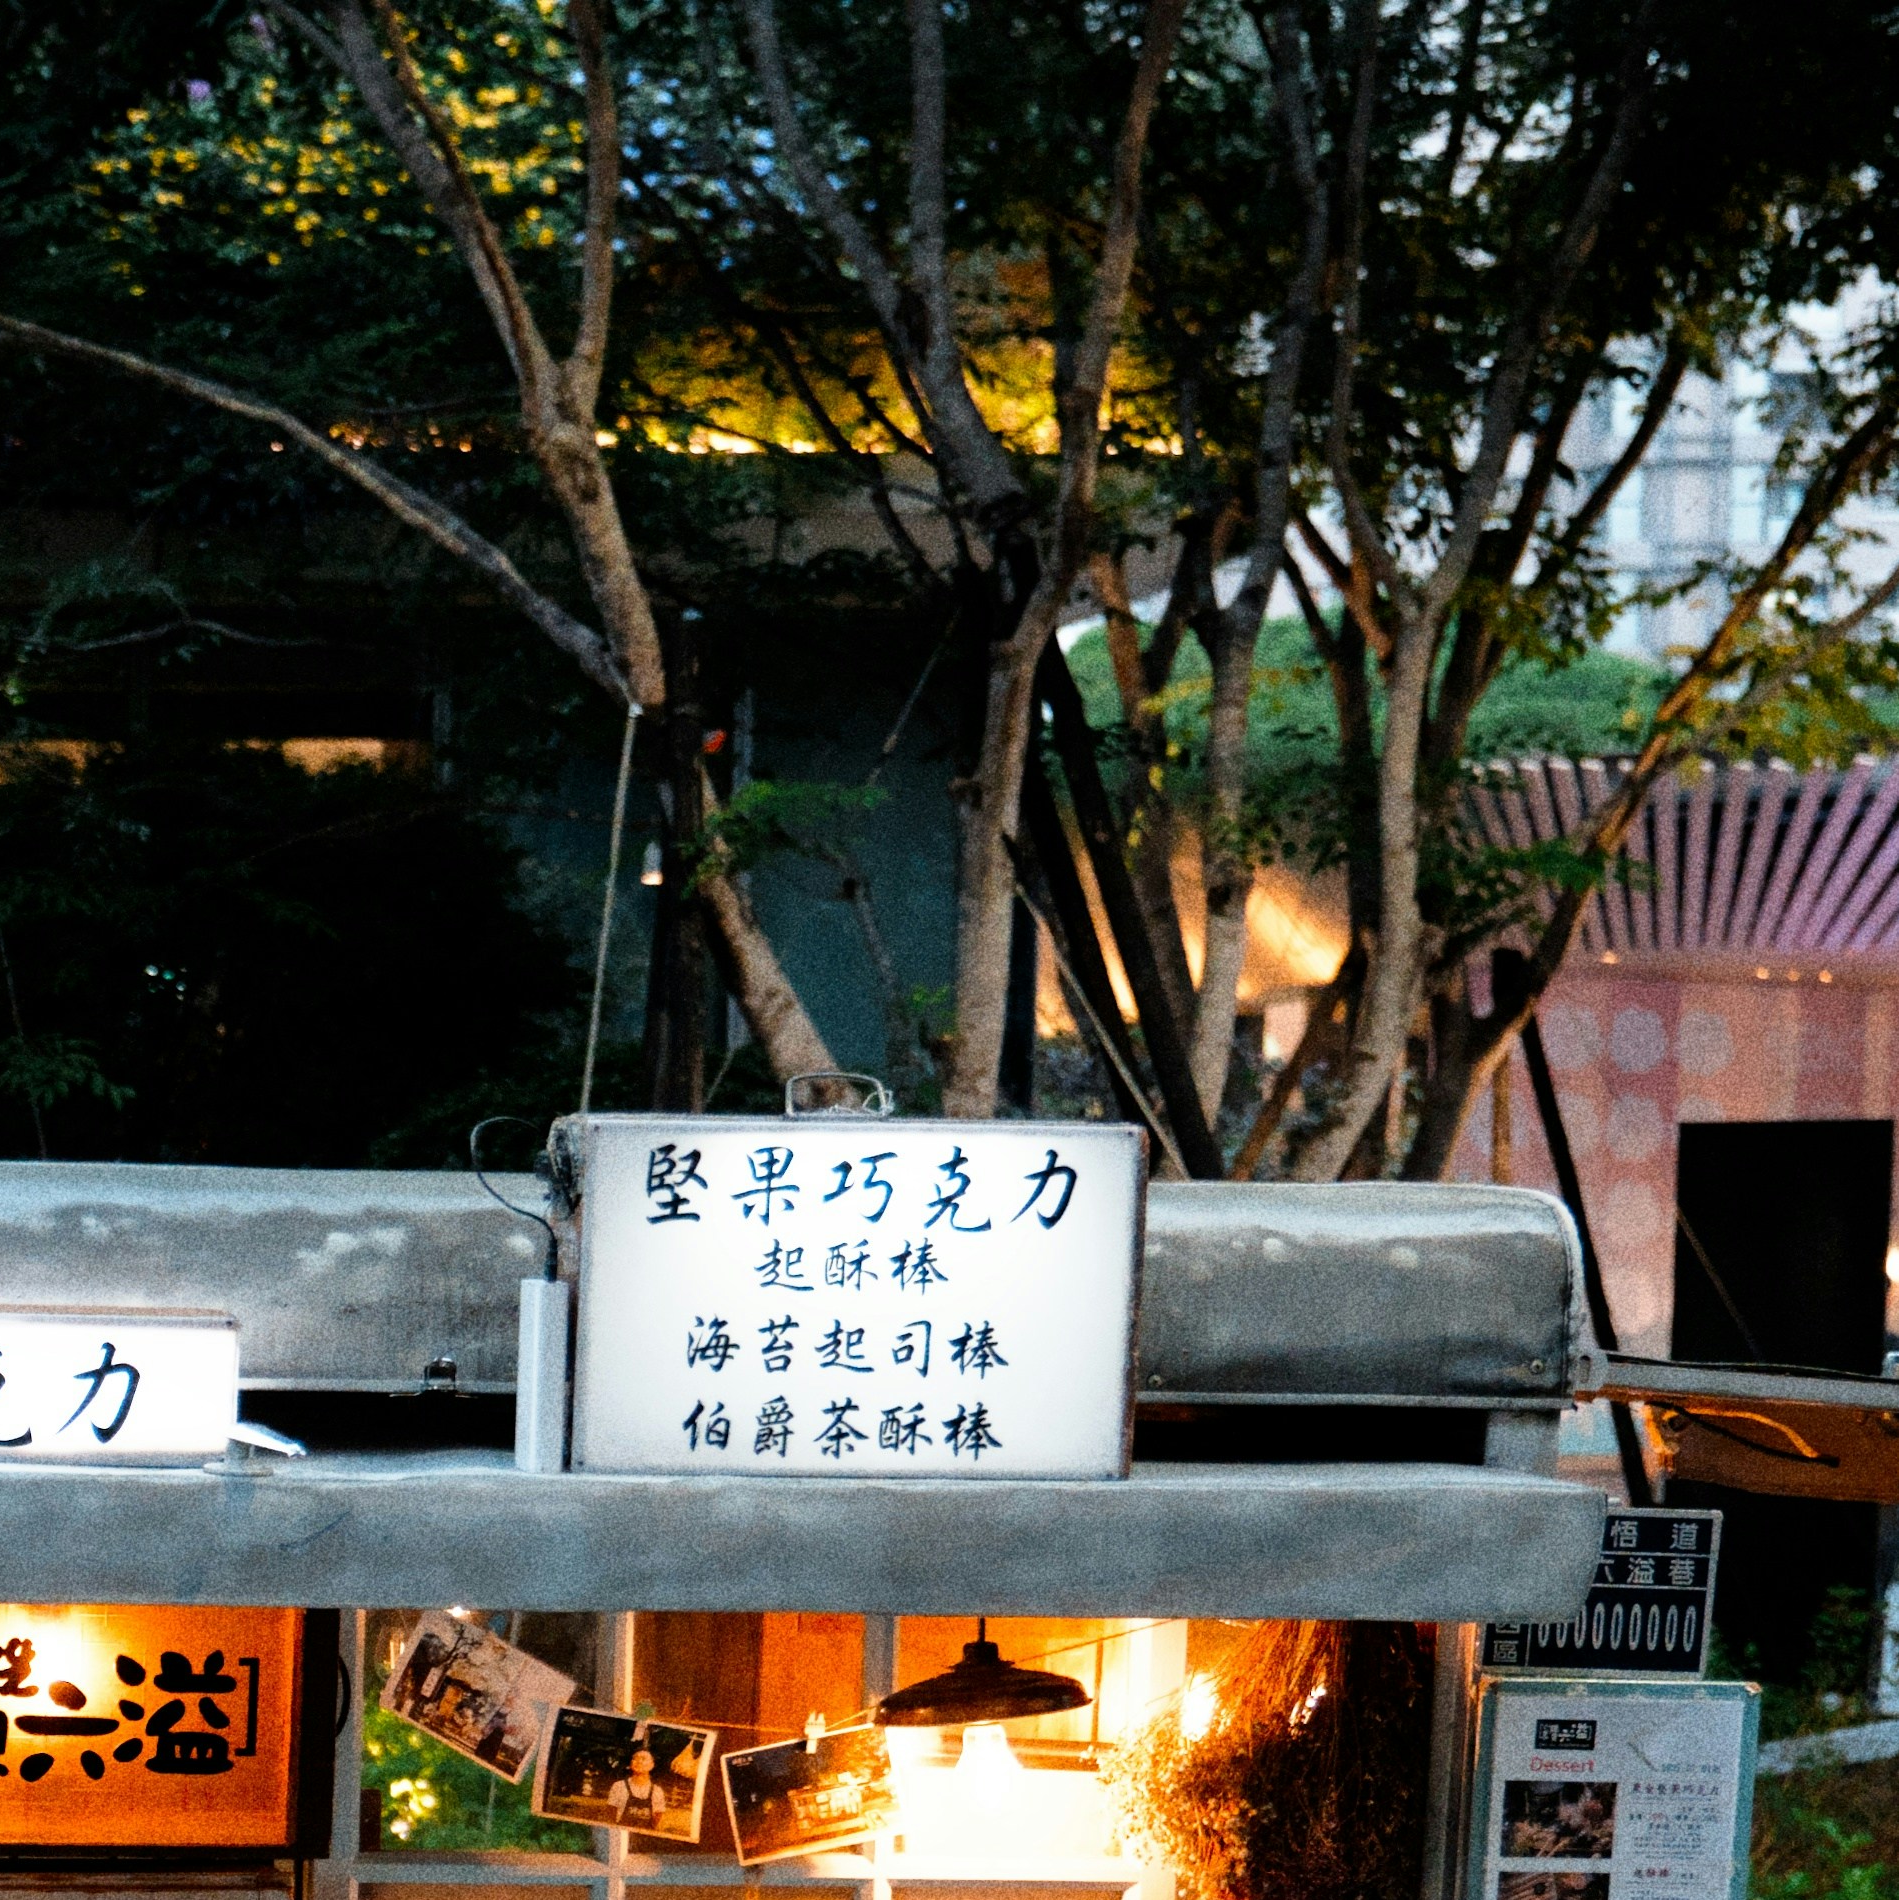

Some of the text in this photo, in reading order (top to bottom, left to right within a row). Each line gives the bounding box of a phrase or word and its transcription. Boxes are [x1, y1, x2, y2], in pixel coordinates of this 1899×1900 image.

[645, 1142, 1079, 1233] 堅果巧克力
[753, 1237, 950, 1295] 起酥棒
[686, 1314, 1010, 1380] 海苔起司棒
[682, 1394, 1003, 1462] 伯爵茶酥棒
[1529, 1756, 1595, 1773] Dessert
